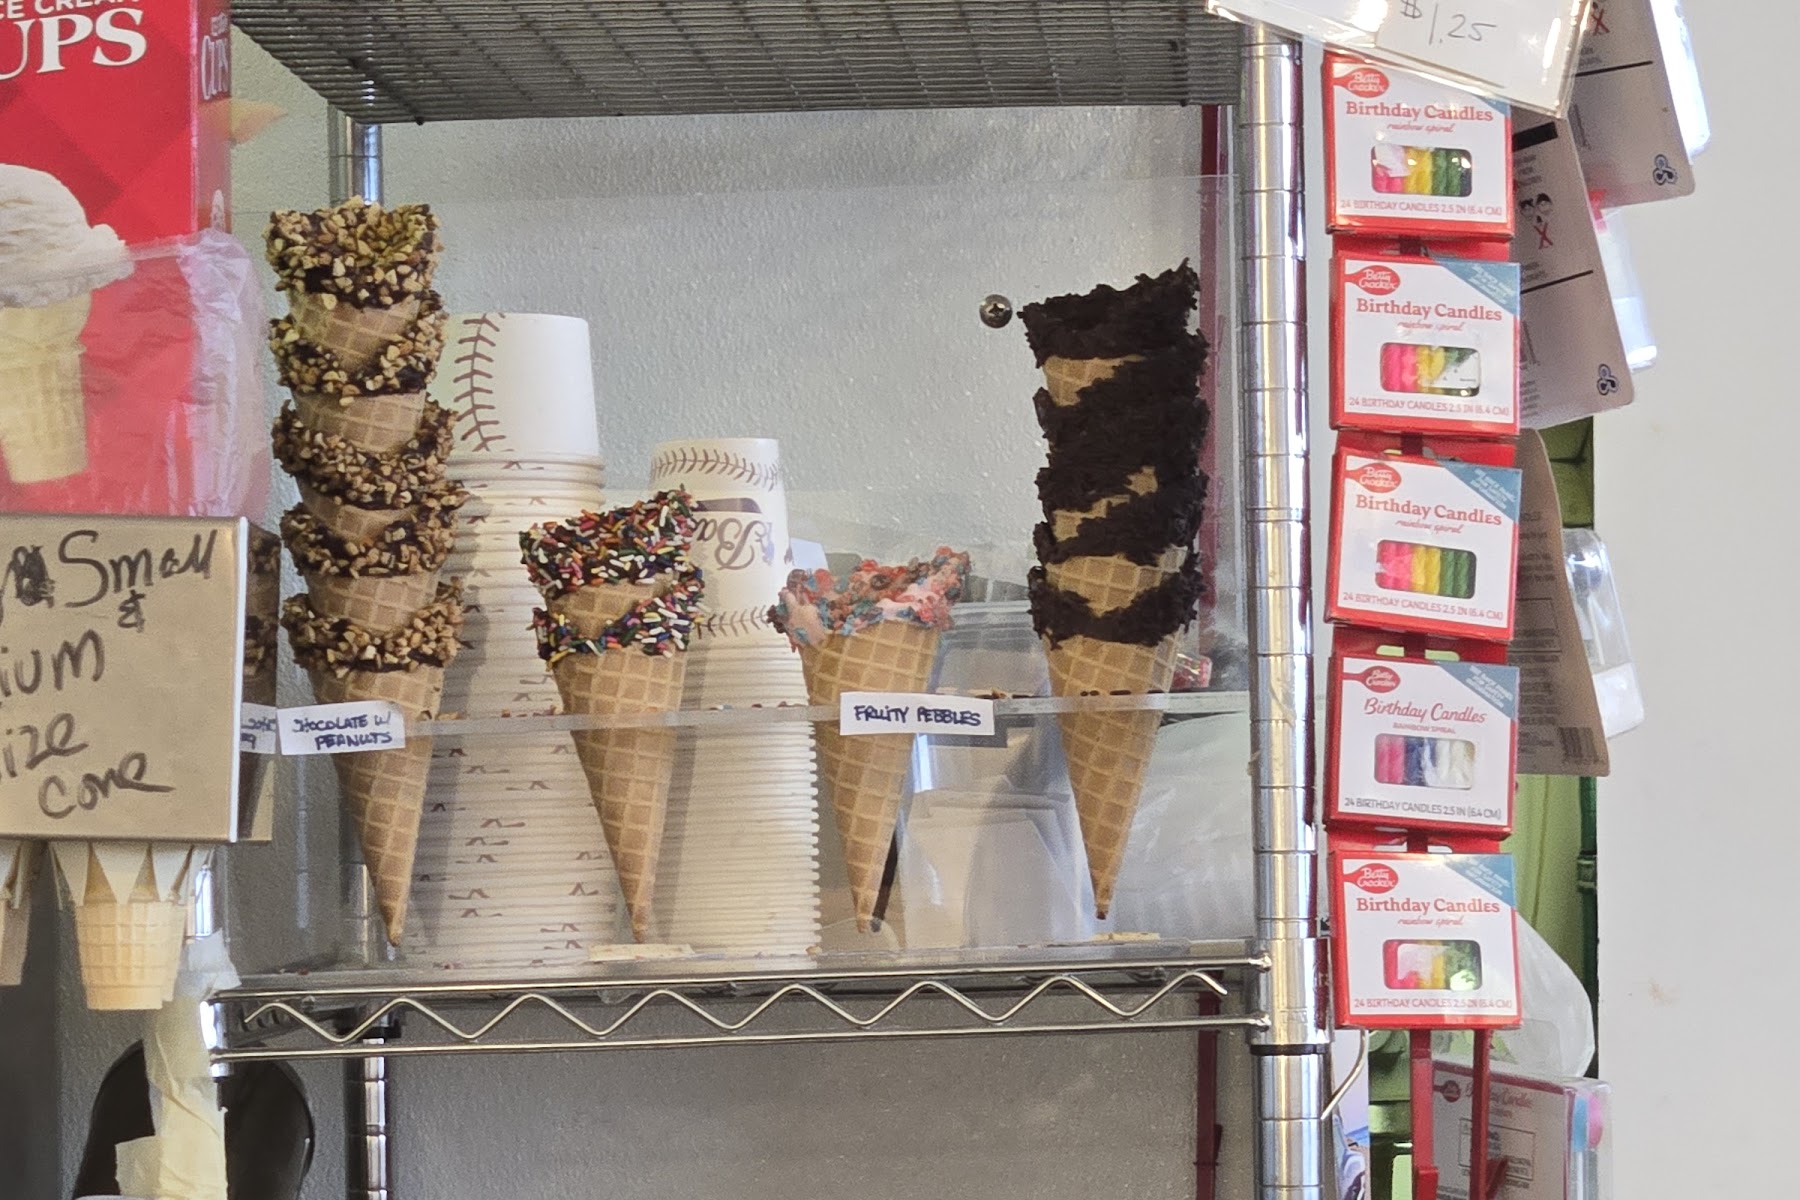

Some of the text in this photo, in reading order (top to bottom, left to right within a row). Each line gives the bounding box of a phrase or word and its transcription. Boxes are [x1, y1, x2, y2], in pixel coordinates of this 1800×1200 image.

[1346, 102, 1493, 121] Birthday Candles
[1354, 201, 1397, 209] BIRTHDAY
[1399, 202, 1439, 212] CANDLES
[1356, 298, 1502, 320] Birthday Candles
[1362, 398, 1404, 408] BIRTHDAY
[1407, 400, 1447, 411] CANDLES
[1356, 494, 1501, 525] Birthday Candles
[58, 529, 218, 608] Small
[1356, 594, 1399, 606] BIRTHDAY
[1402, 599, 1441, 613] CANDLES
[917, 707, 981, 727] PEBBLES
[1365, 698, 1487, 723] Birthday Candles
[0, 713, 89, 778] ize
[315, 732, 393, 751] PEANUTS
[1356, 799, 1400, 811] BIRTHDAY
[1402, 802, 1441, 814] CANDLES
[1356, 898, 1500, 915] Birthday Candles
[1367, 999, 1410, 1008] BIRTHDAY
[1413, 1000, 1451, 1008] CANDLES
